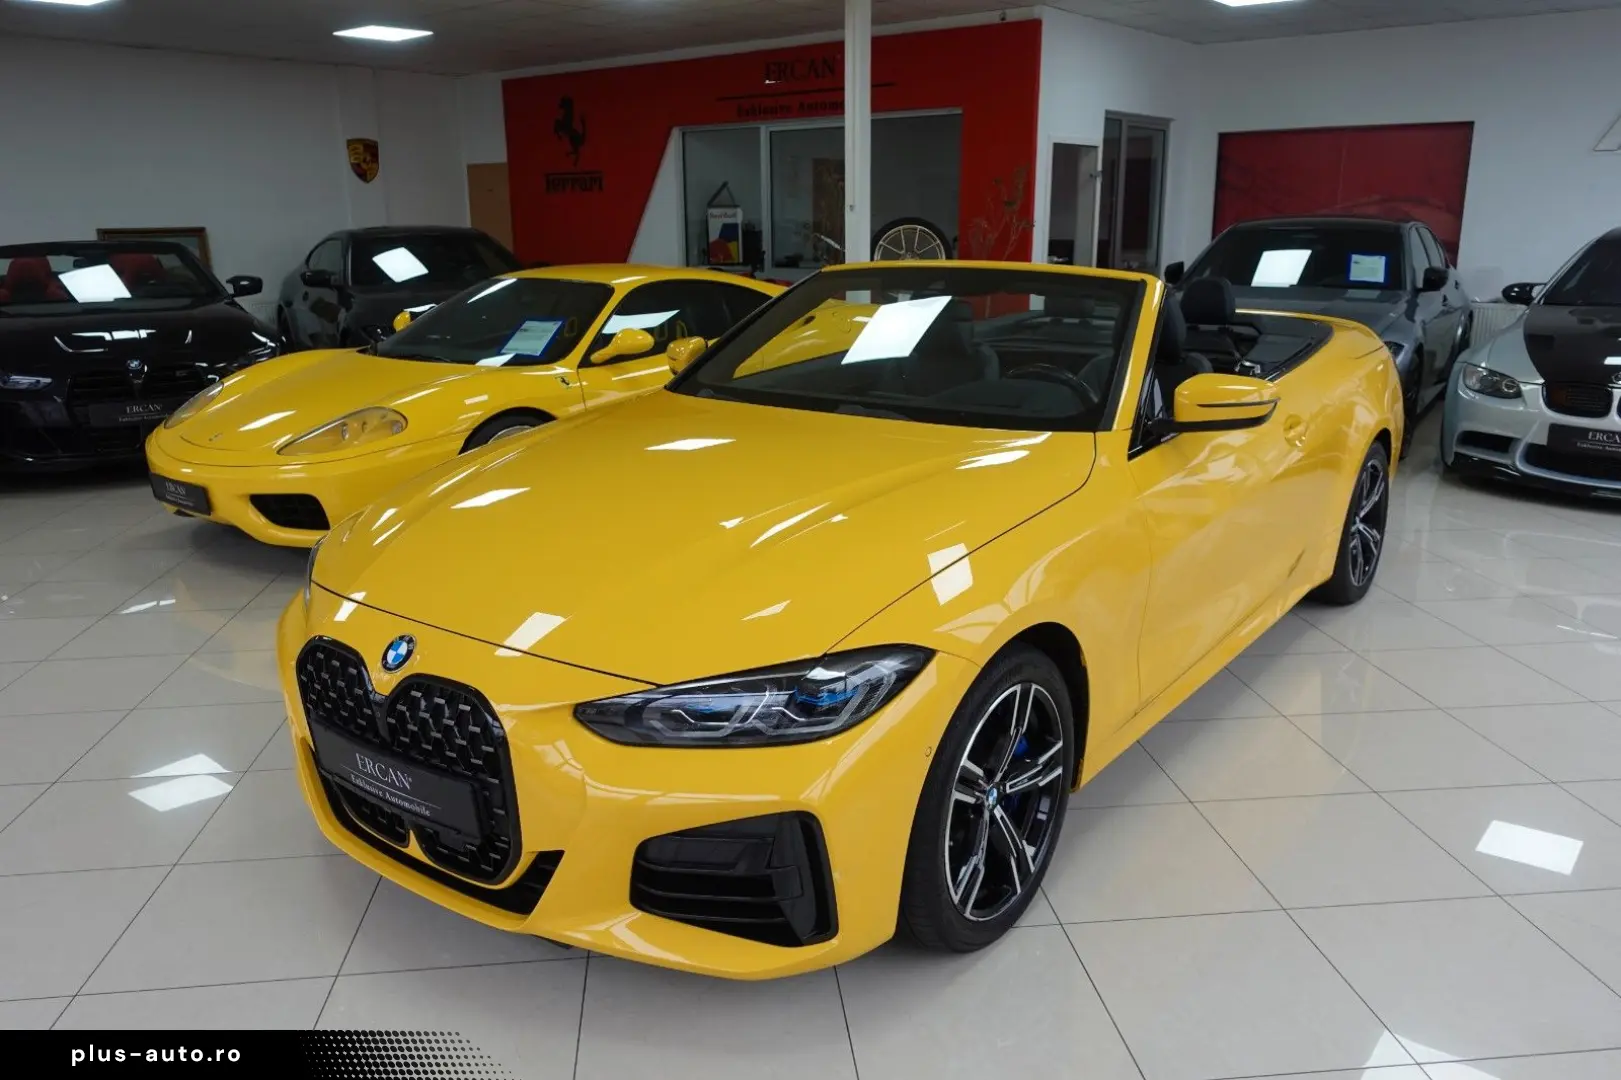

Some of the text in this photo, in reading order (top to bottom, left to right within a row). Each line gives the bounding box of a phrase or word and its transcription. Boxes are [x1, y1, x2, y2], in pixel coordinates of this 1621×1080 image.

[764, 57, 836, 83] ERCAN
[356, 753, 411, 790] ERCAN
[351, 774, 430, 817] Exklusive Automobile
